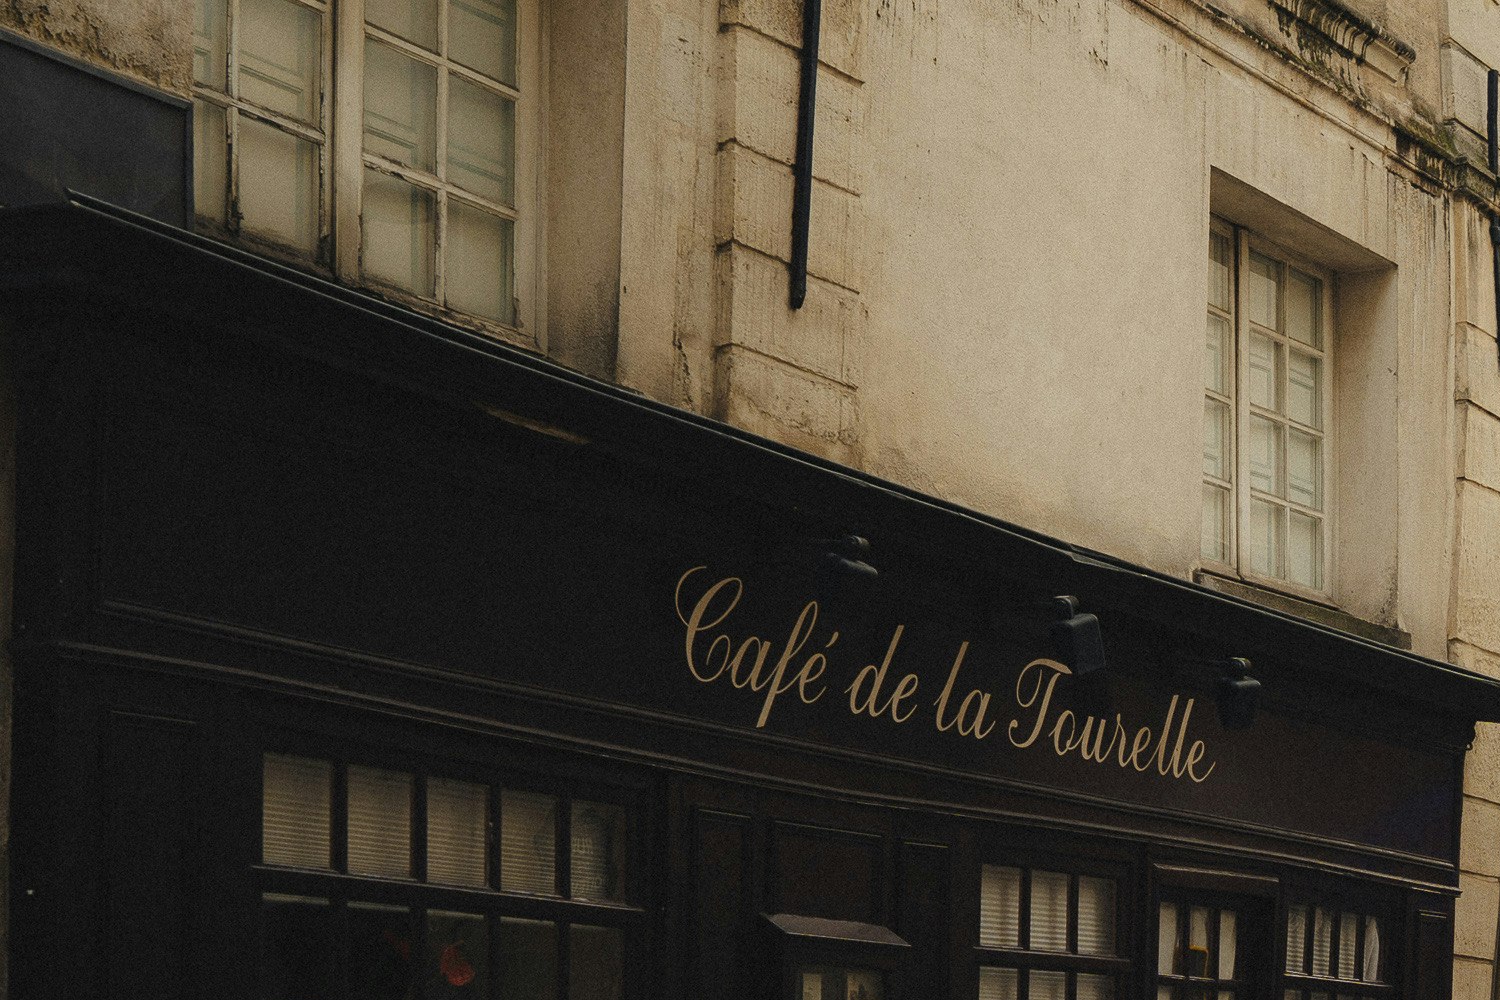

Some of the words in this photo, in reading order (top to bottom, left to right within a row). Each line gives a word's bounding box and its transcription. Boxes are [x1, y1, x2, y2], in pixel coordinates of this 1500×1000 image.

[675, 566, 840, 729] Café
[844, 625, 918, 723] de
[932, 641, 995, 740] la
[1009, 657, 1216, 783] Tourelle
